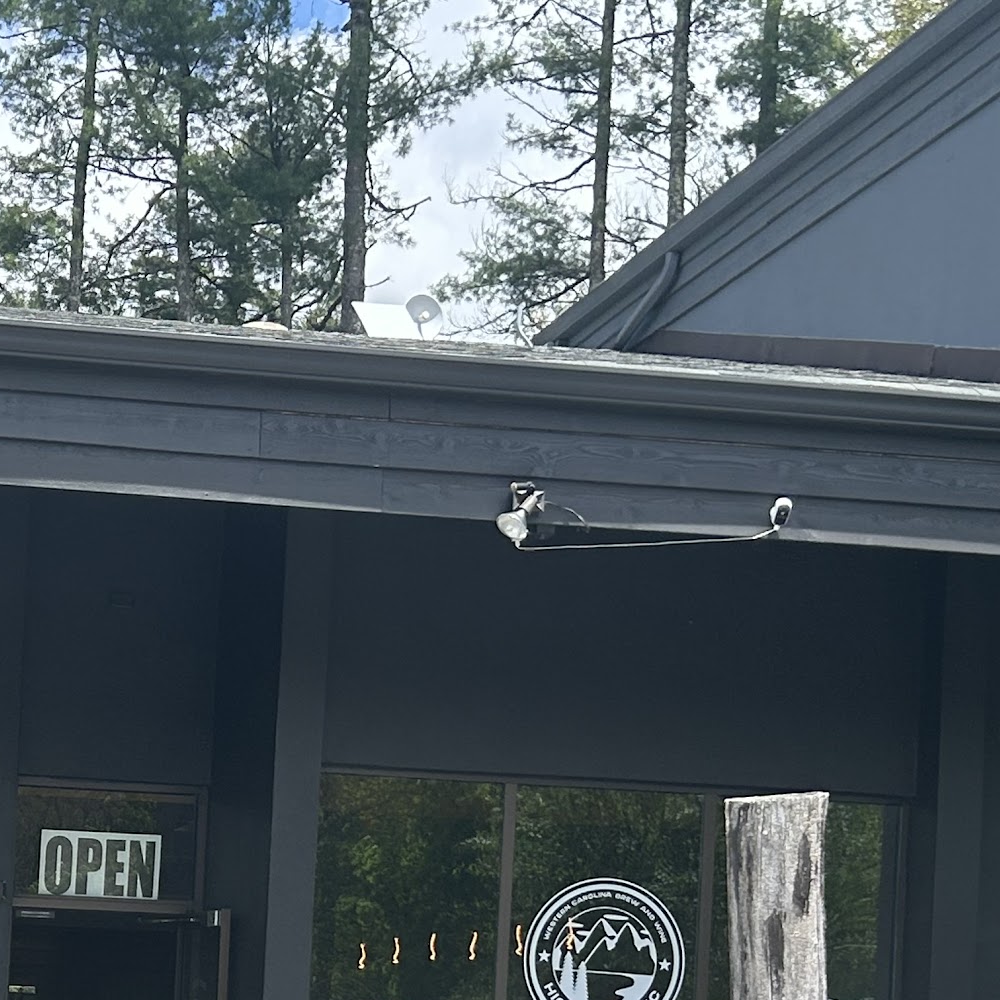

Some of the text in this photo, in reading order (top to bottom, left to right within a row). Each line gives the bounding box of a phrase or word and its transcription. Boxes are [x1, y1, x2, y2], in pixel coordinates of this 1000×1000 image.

[44, 835, 156, 898] OPEN
[543, 891, 667, 944] WESTERN CAROLINA BREW AND WINE
